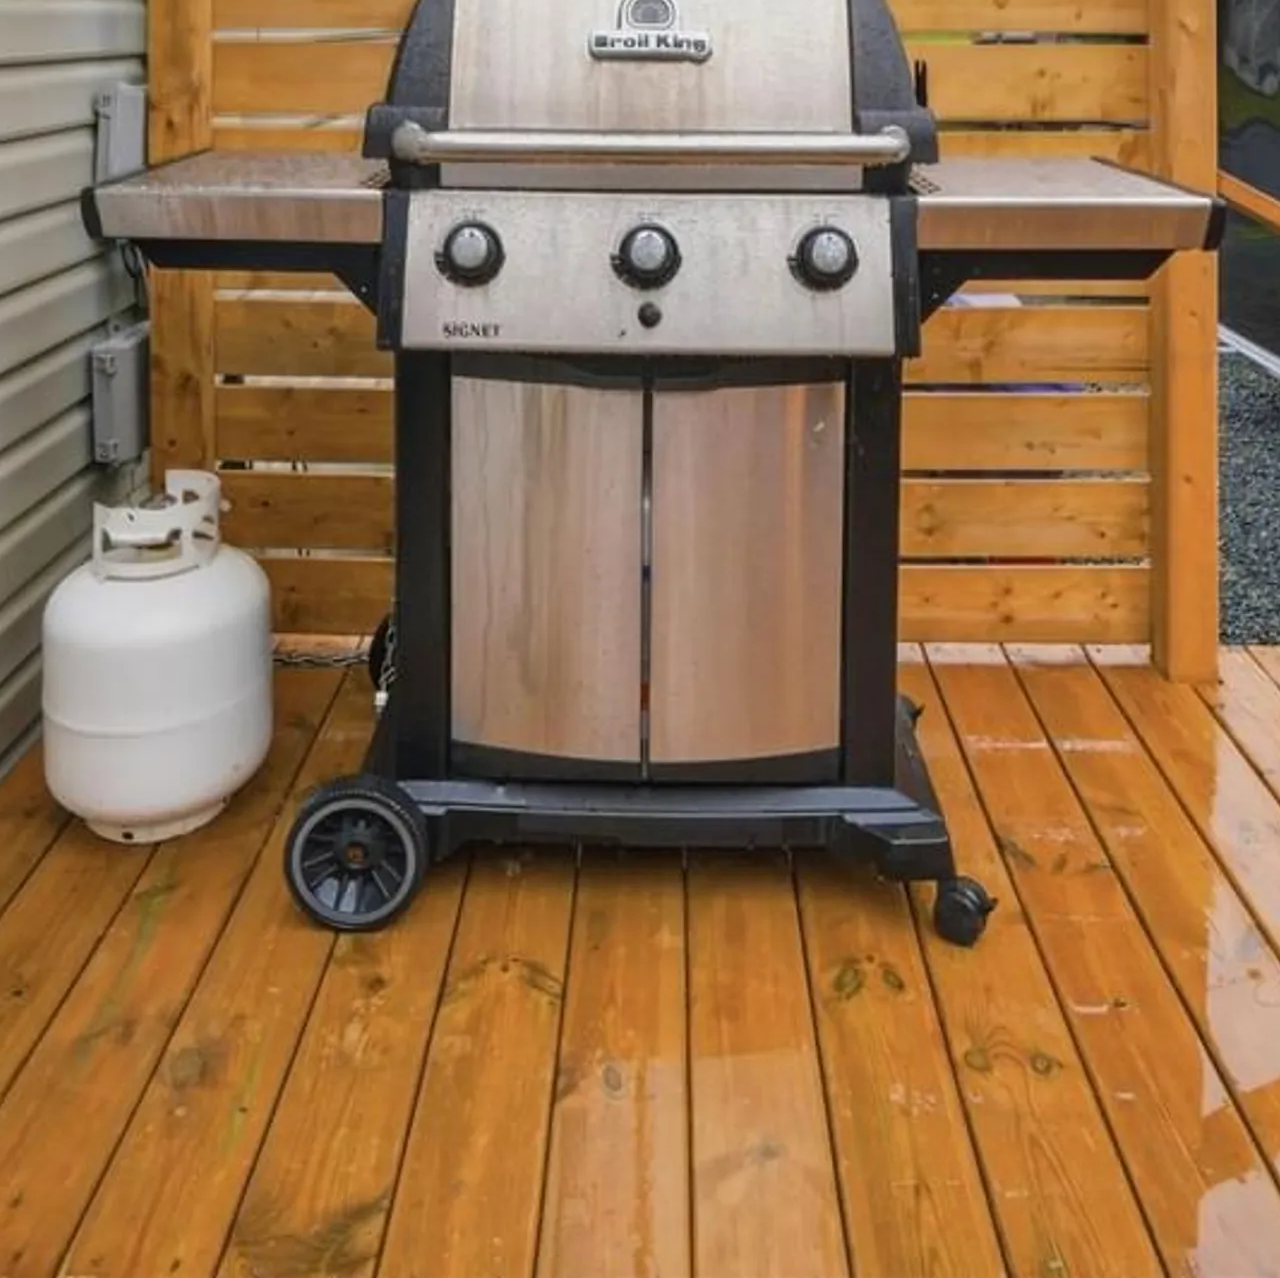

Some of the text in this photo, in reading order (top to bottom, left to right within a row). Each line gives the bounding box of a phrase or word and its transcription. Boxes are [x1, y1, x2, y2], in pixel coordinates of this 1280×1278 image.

[594, 34, 706, 52] Broil King
[442, 322, 500, 338] SIGNET
